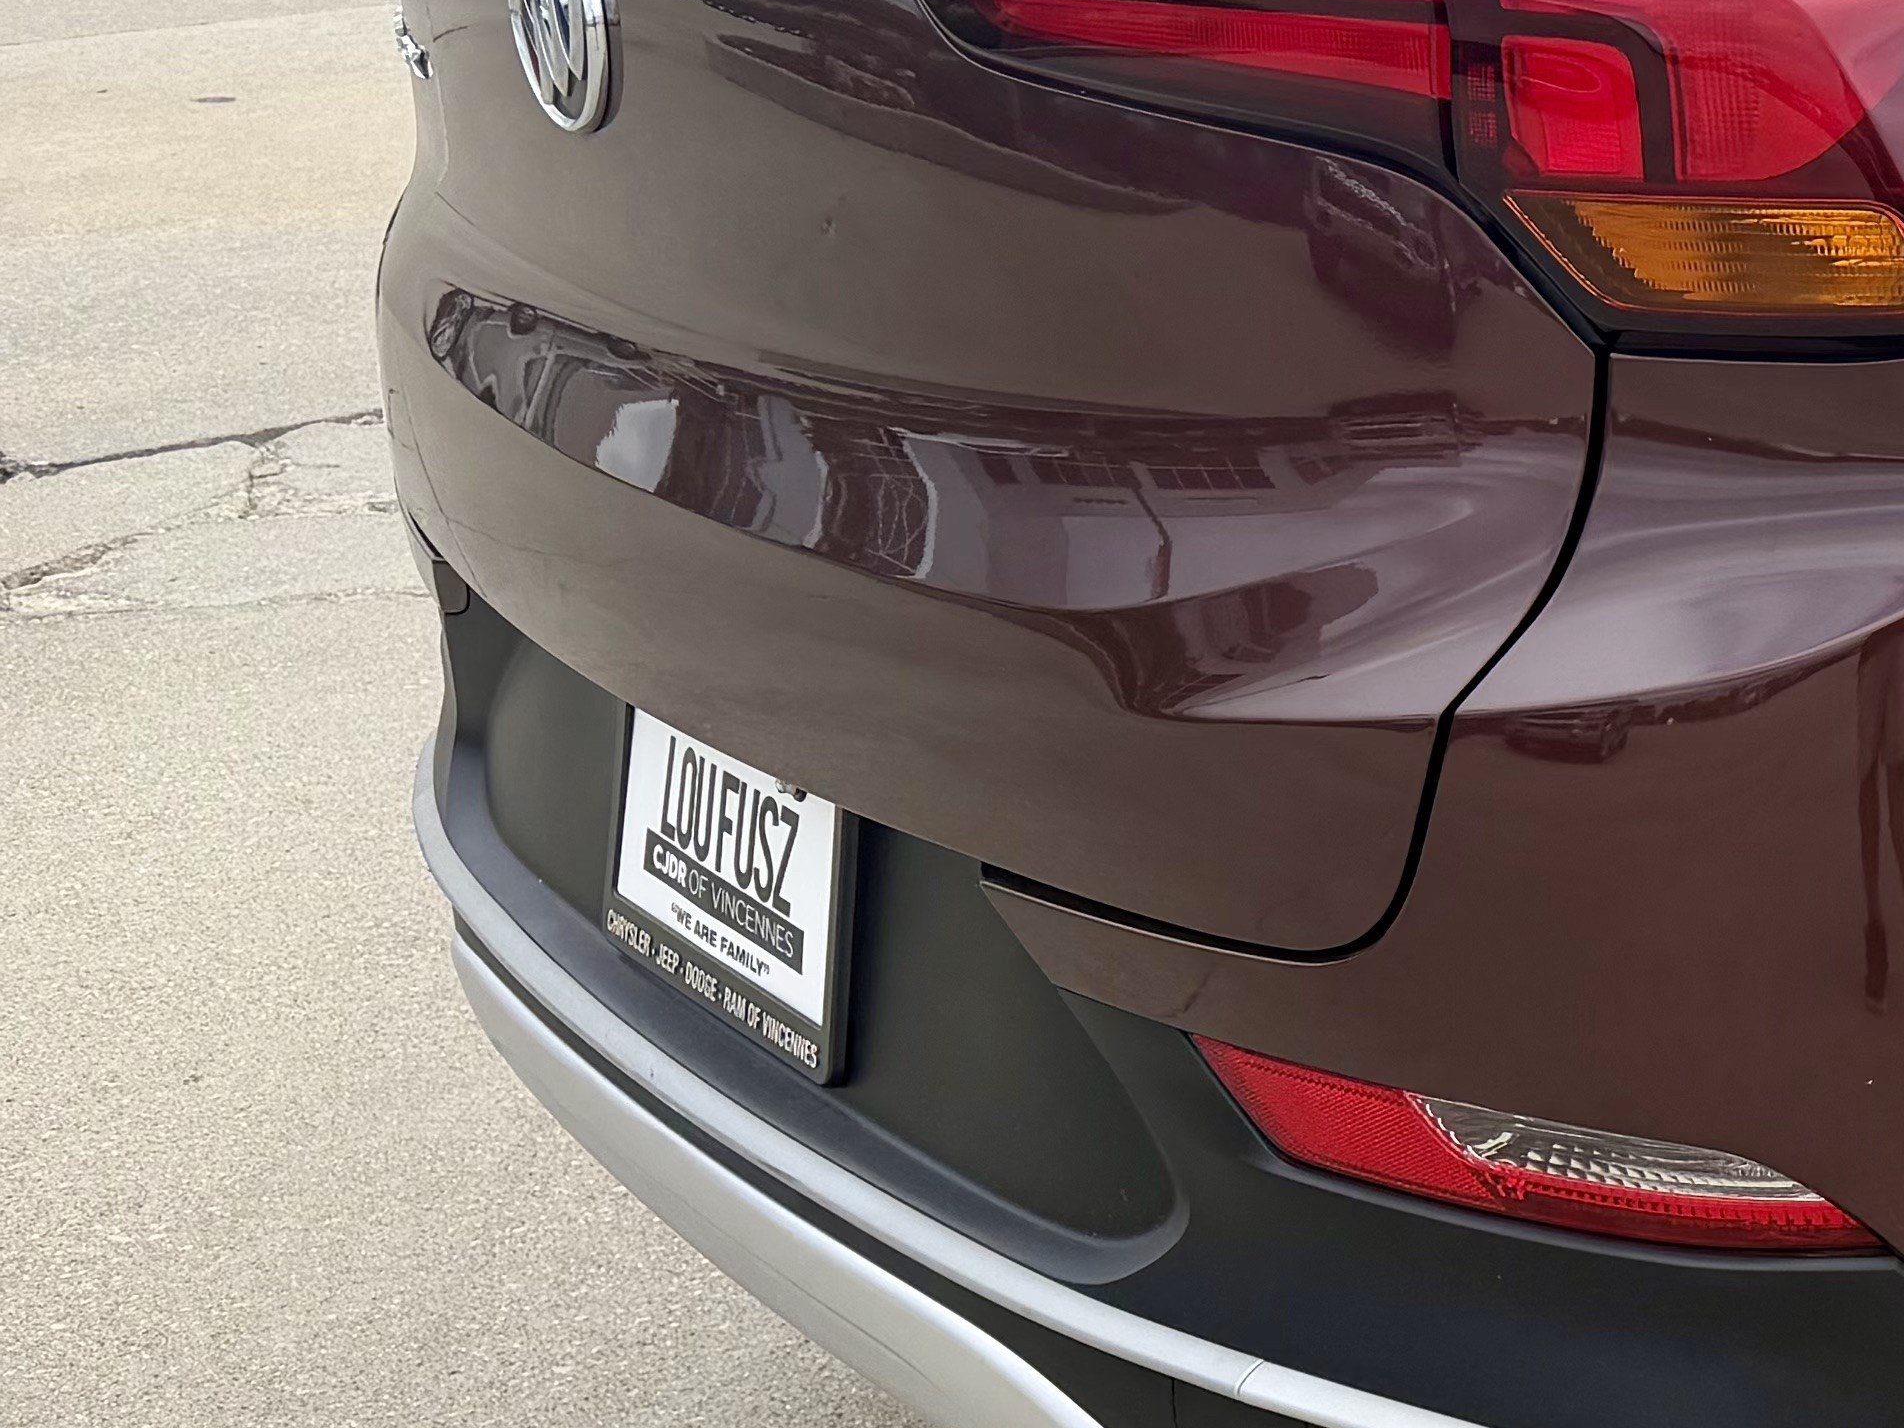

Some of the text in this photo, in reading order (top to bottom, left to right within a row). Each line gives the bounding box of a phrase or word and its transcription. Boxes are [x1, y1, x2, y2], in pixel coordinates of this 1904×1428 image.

[661, 735, 801, 918] LOU FUSZ
[652, 843, 796, 958] CJDR OF VINCENNES
[694, 919, 718, 948] ARE
[606, 908, 819, 1069] CHRYSLER JEEP DODGE RAM OF VINCENNES
